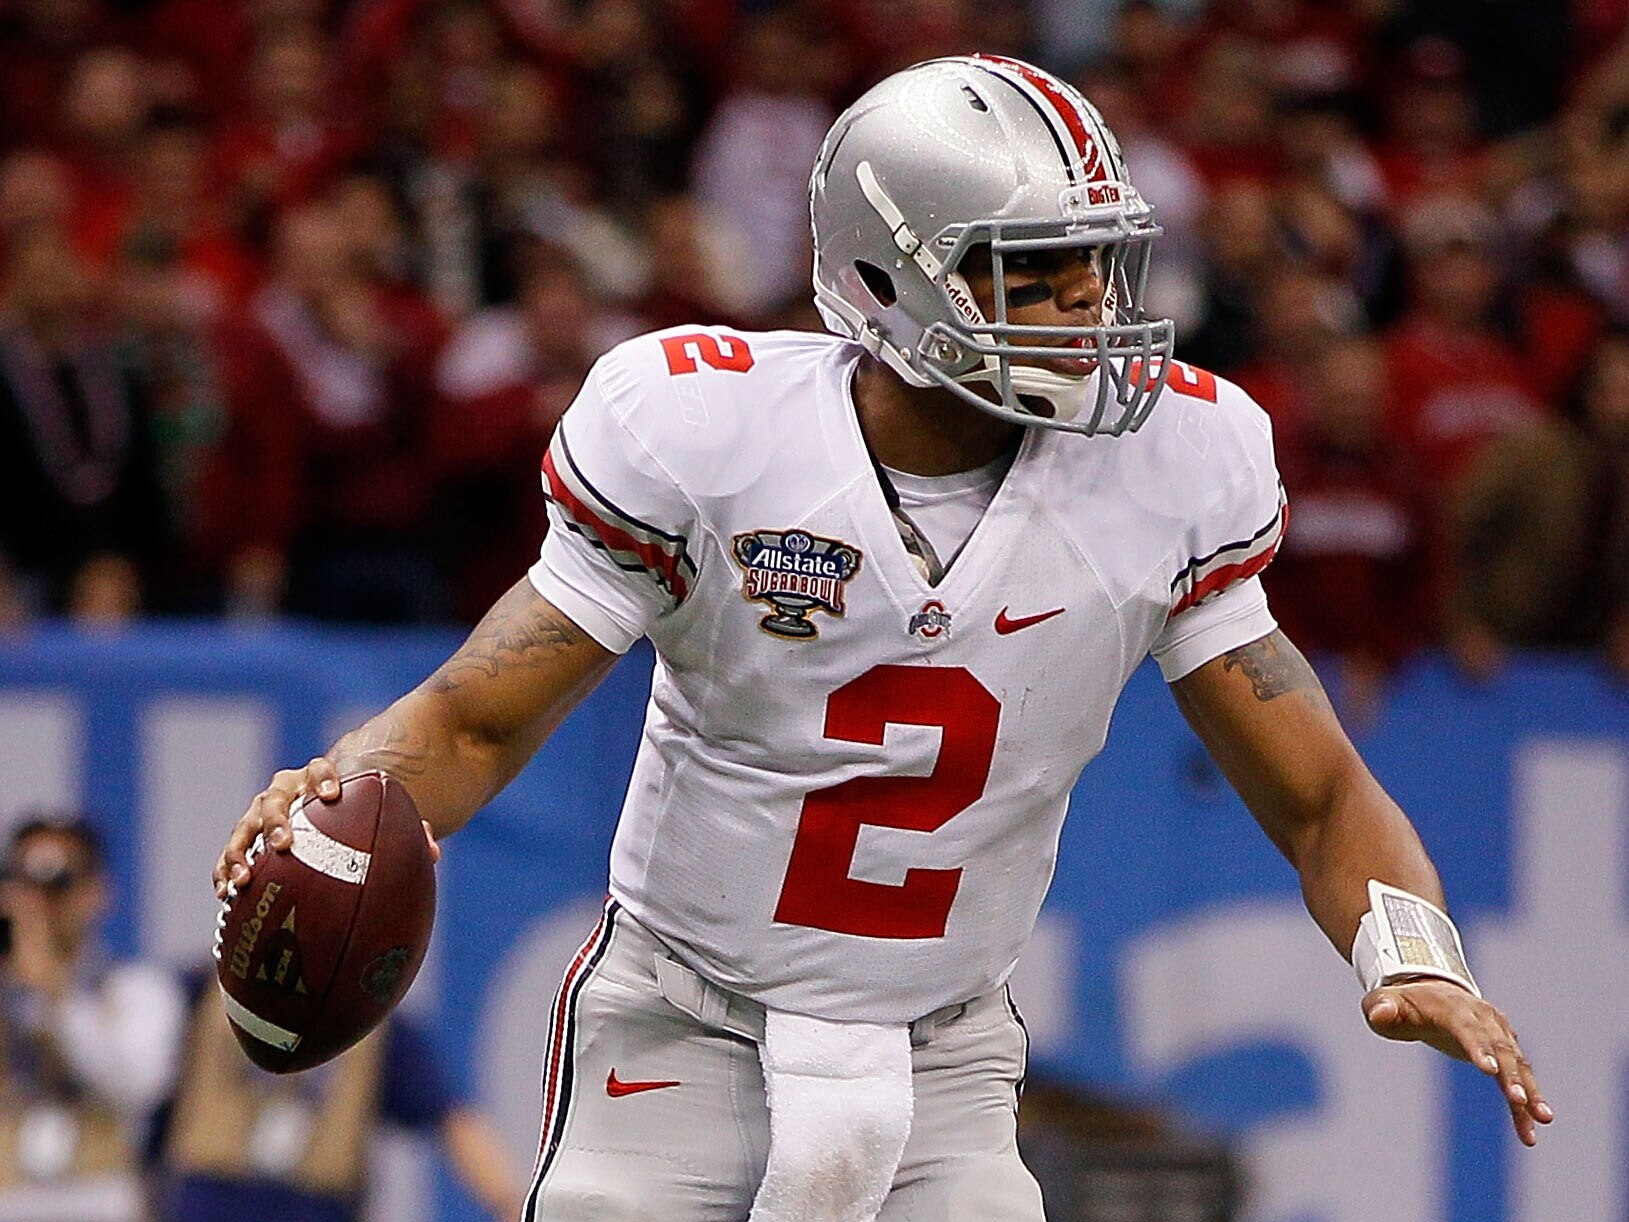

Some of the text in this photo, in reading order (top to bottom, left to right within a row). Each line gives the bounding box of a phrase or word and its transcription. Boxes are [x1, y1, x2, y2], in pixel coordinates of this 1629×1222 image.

[659, 333, 756, 377] 2
[751, 548, 840, 579] Allstate
[773, 664, 1001, 939] 2
[230, 882, 283, 980] Wilson
